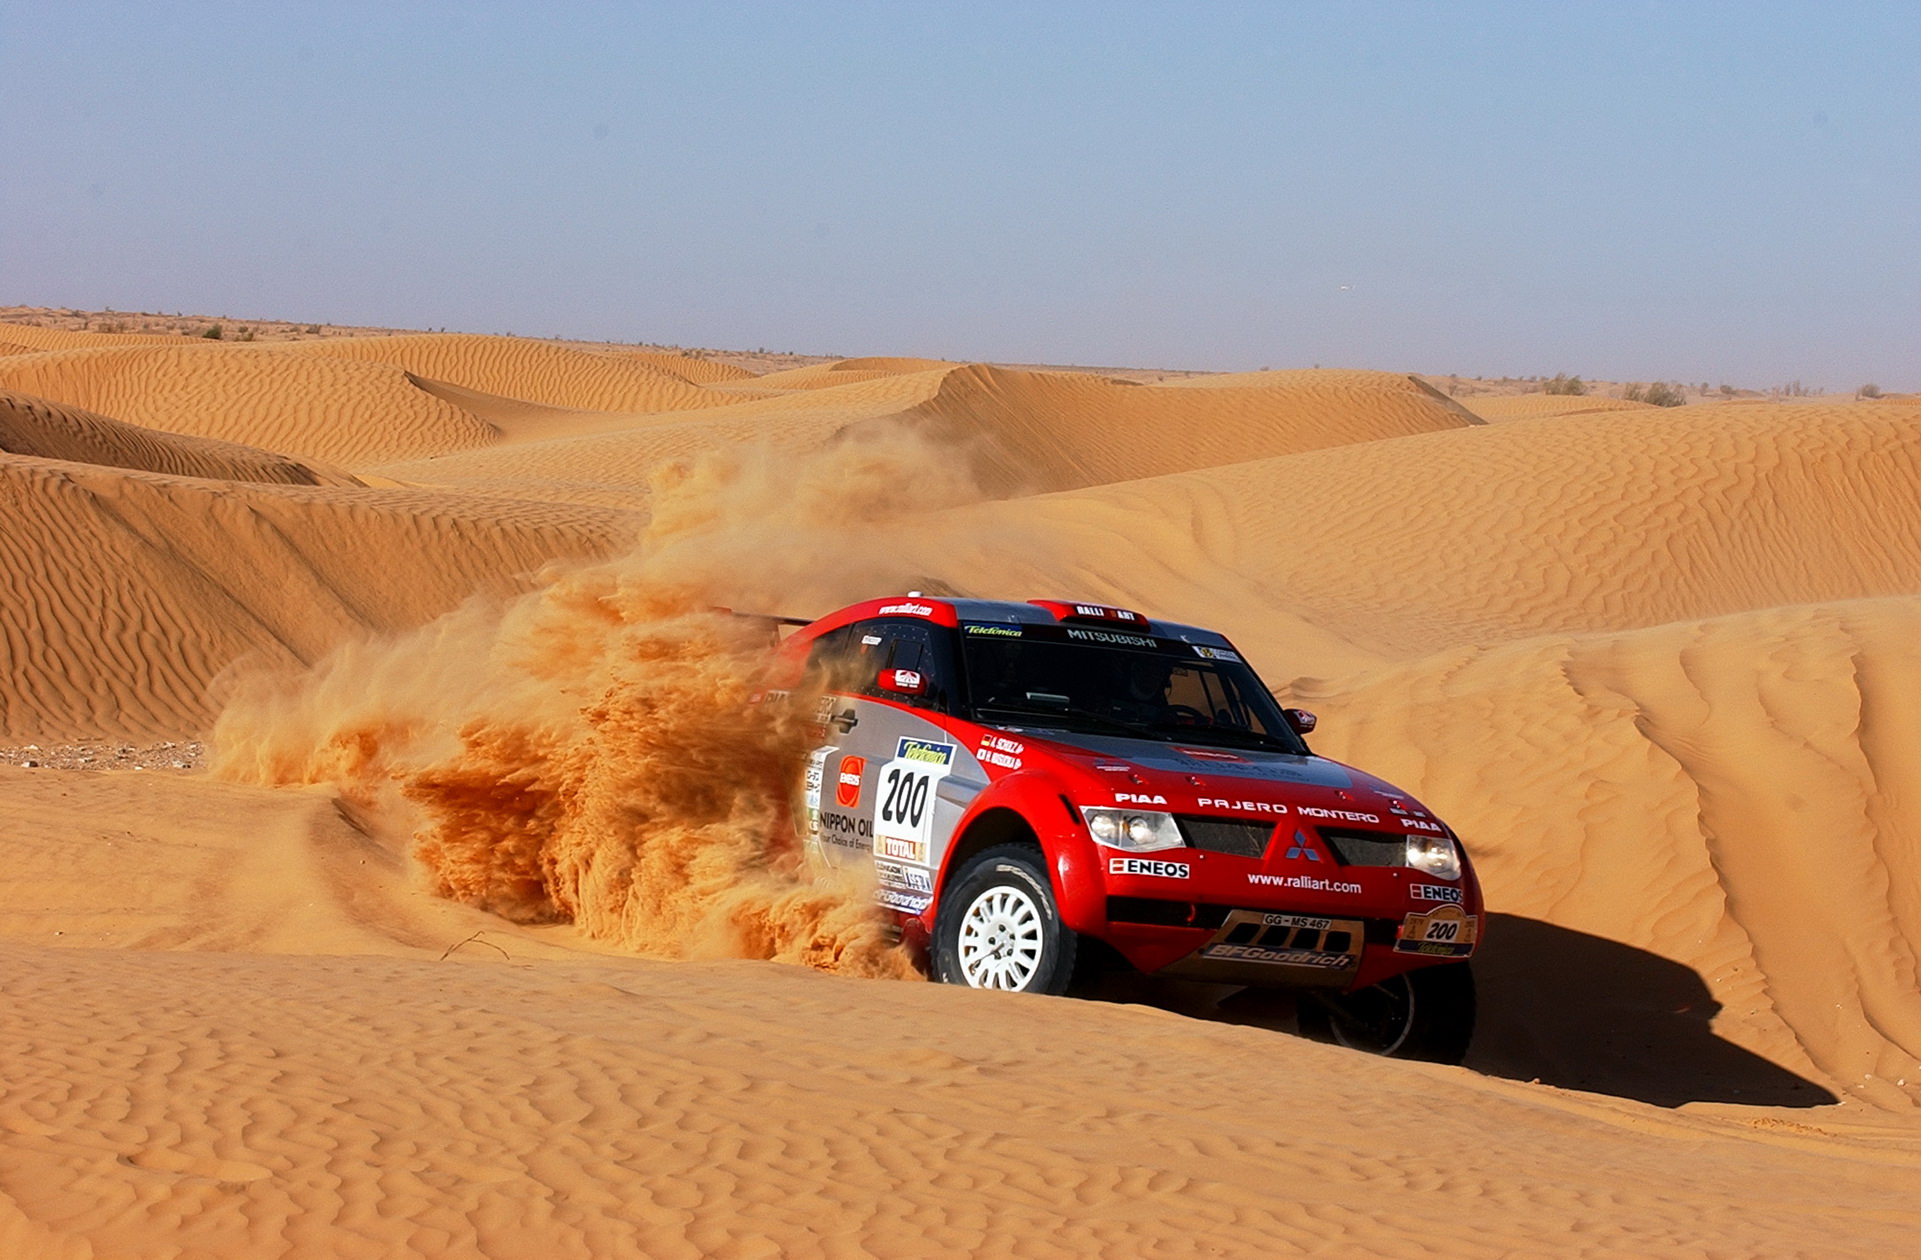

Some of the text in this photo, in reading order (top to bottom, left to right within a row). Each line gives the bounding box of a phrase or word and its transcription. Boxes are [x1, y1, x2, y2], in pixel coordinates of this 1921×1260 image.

[1067, 629, 1158, 648] MITSUBISHI
[882, 768, 930, 829] 200
[1115, 793, 1168, 805] PIAA
[1197, 797, 1380, 824] PAJERO MONTERO
[820, 811, 856, 835] NIPPON
[858, 817, 874, 839] OIL
[1400, 817, 1443, 833] PIAA
[885, 838, 916, 859] TOTAL
[1127, 859, 1190, 879] ENEOS
[1247, 873, 1362, 894] www.ralliart.com
[1265, 914, 1282, 925] GG
[1291, 916, 1307, 928] MS
[1309, 917, 1330, 930] 467
[1426, 922, 1458, 940] 200
[1210, 944, 1350, 967] BFGoodrich
